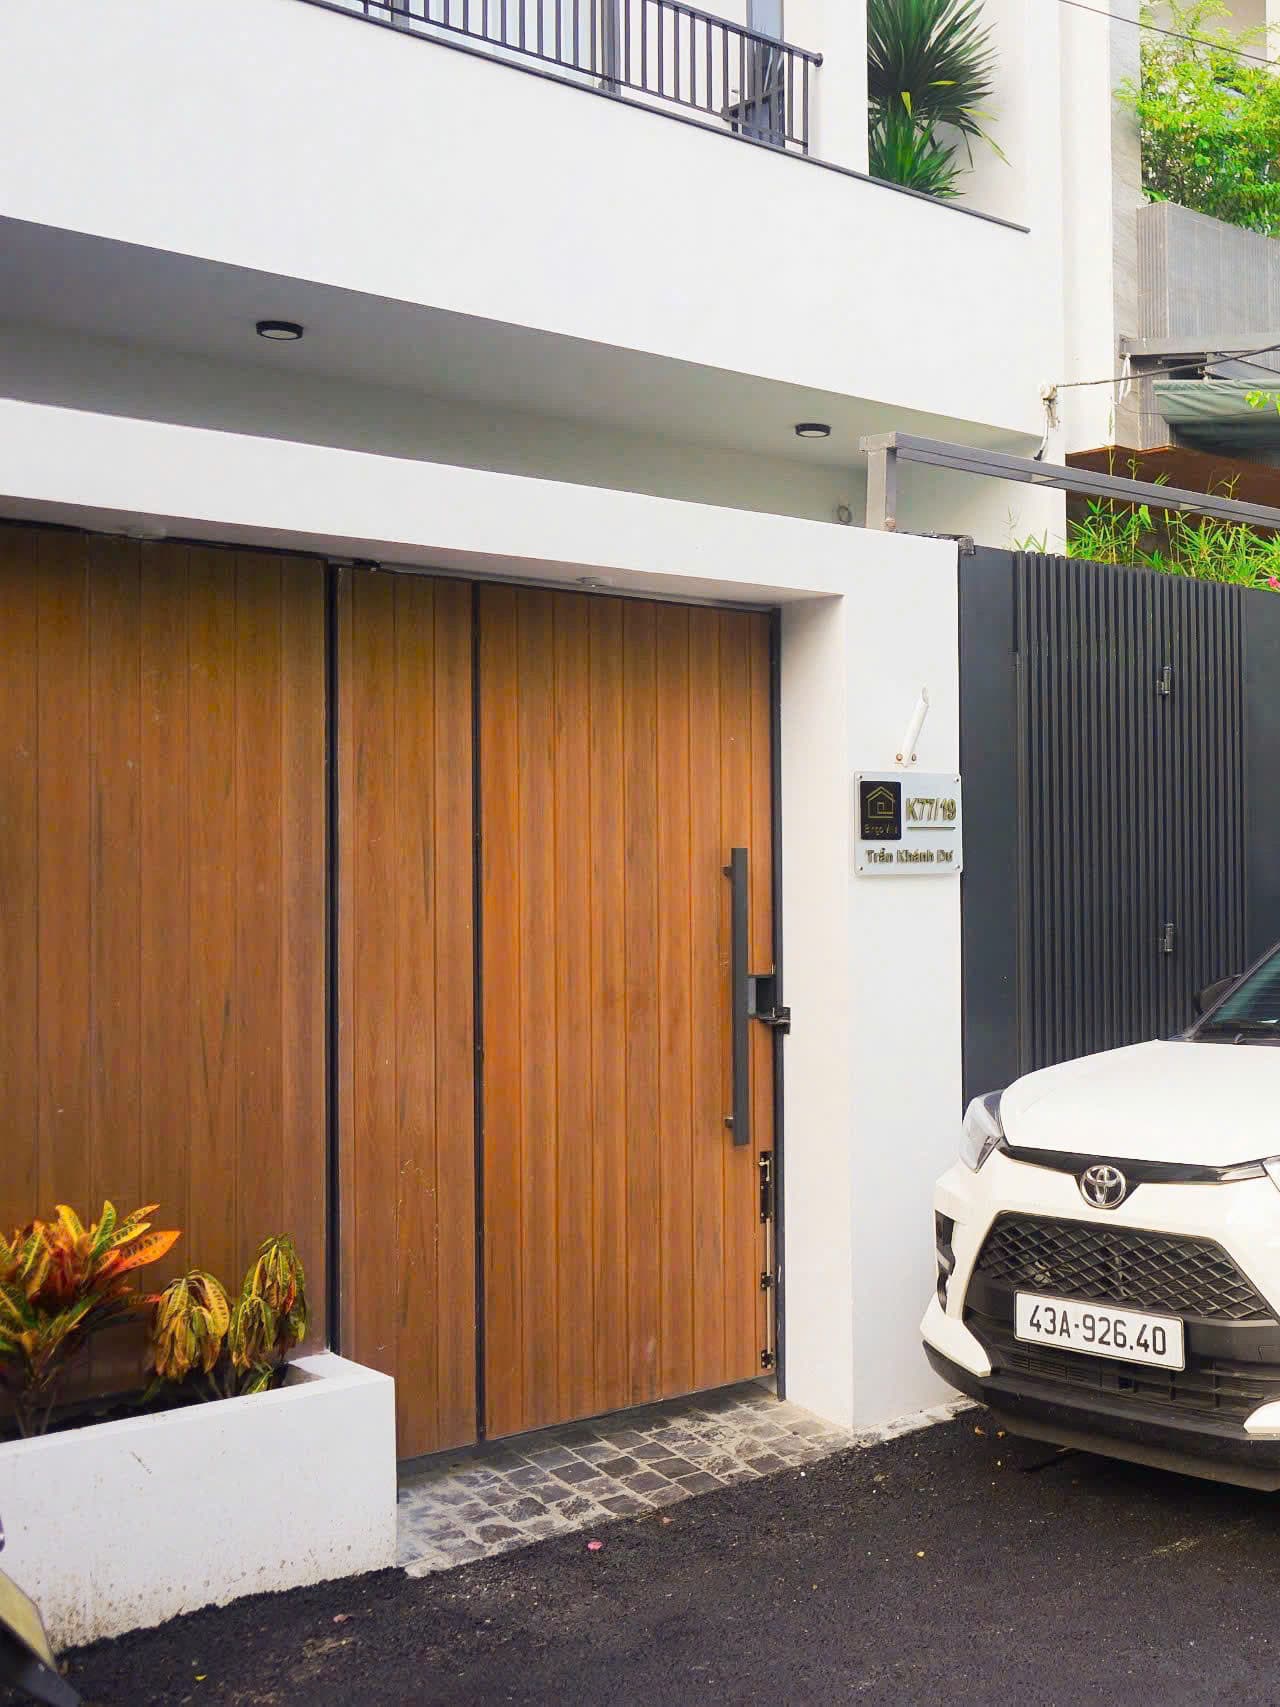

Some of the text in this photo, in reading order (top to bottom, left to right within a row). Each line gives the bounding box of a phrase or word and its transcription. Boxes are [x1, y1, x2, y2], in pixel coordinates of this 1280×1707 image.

[905, 797, 957, 821] K77/19
[896, 849, 934, 863] Khánh
[1029, 1304, 1167, 1356] 43A-926.40
